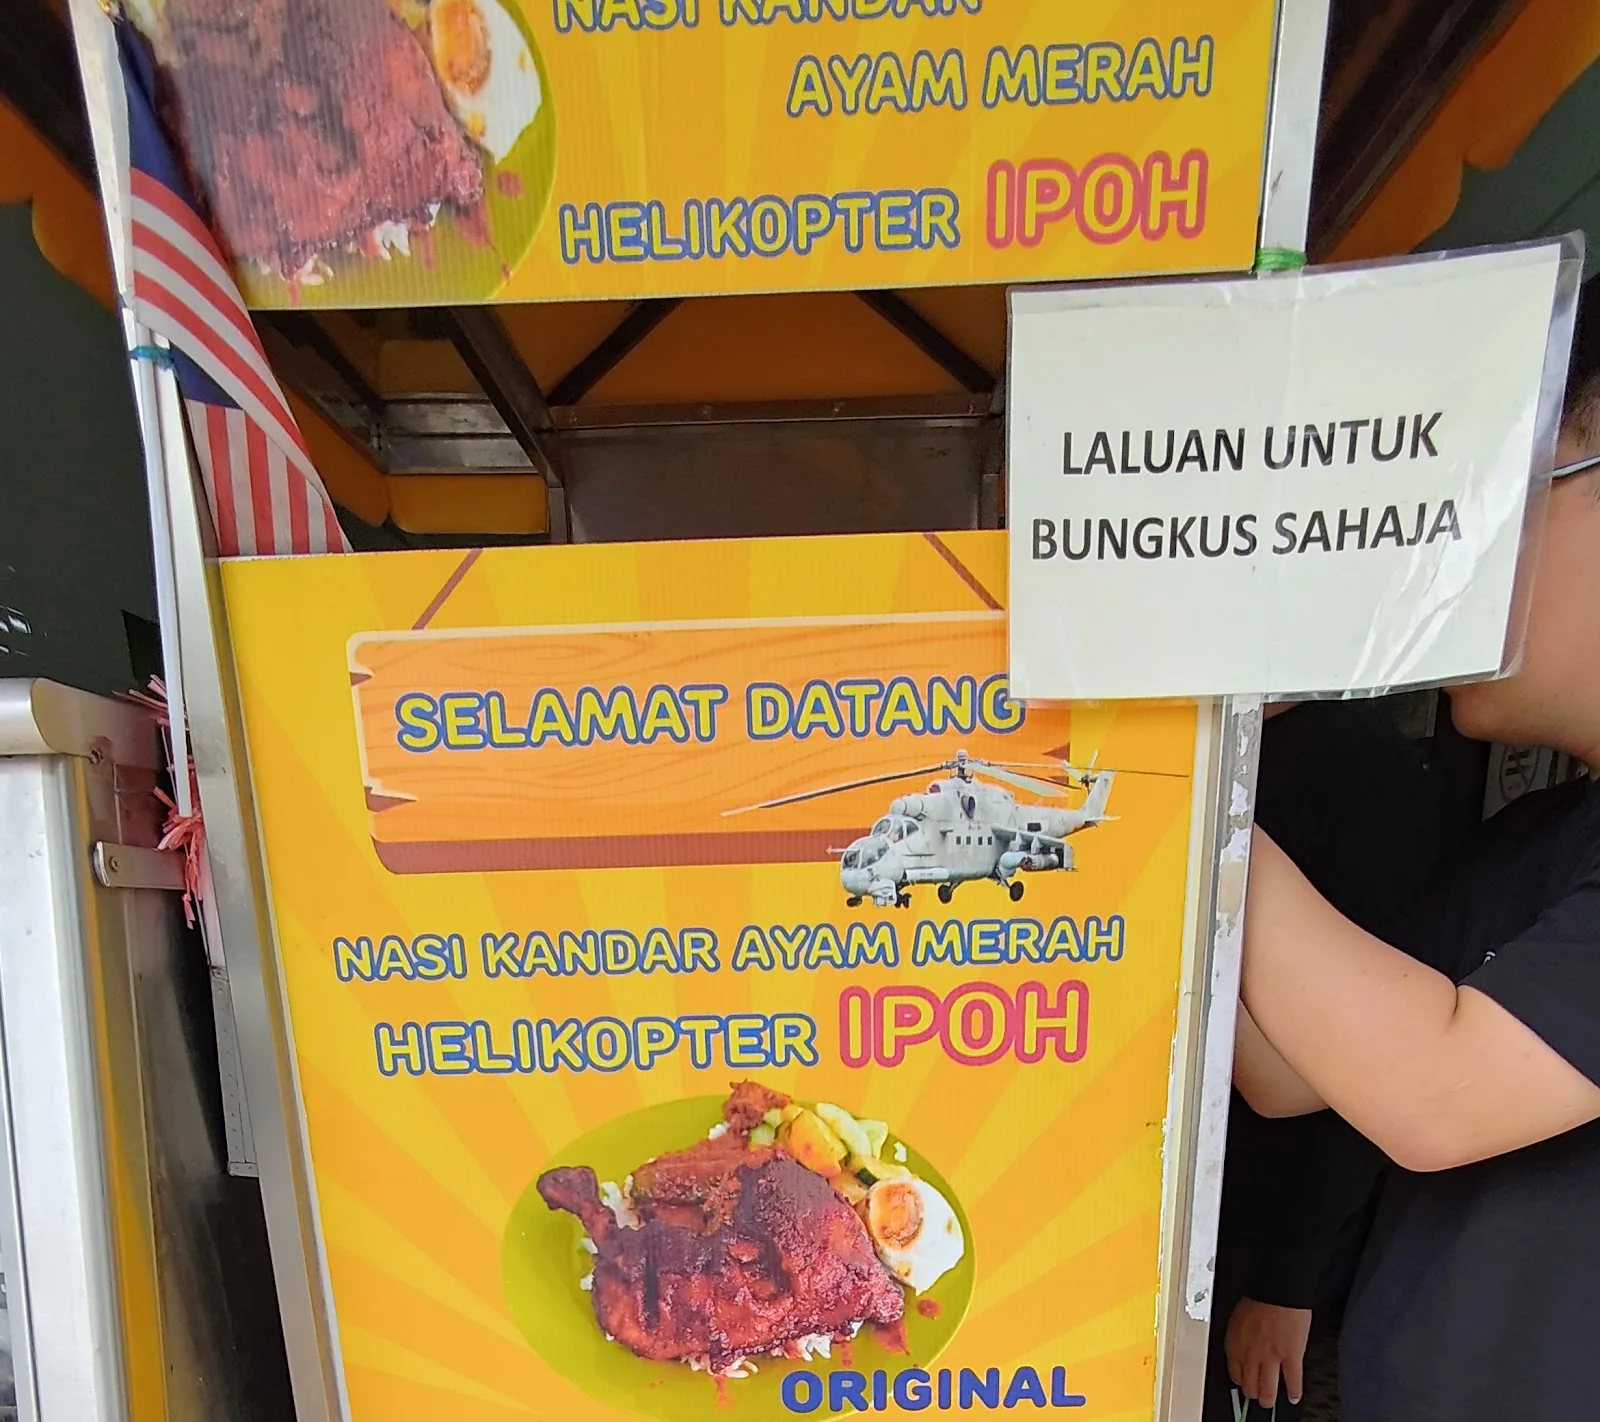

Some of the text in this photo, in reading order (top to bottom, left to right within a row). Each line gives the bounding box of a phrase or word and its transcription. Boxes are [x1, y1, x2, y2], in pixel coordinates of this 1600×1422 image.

[786, 34, 1214, 117] AYAM MERAH
[560, 147, 1209, 264] HELIKOPTER IPOH
[1062, 412, 1444, 476] LALUAN UNTUK
[1031, 499, 1463, 561] BUNGKUS SAHAJA
[394, 674, 1026, 754] SELAMAT DATANG
[334, 915, 1124, 982] NASI KANDAR AYAM MERAH
[373, 980, 1090, 1077] HELIKOPTER IPOH
[780, 1365, 1087, 1414] ORIGINAL
